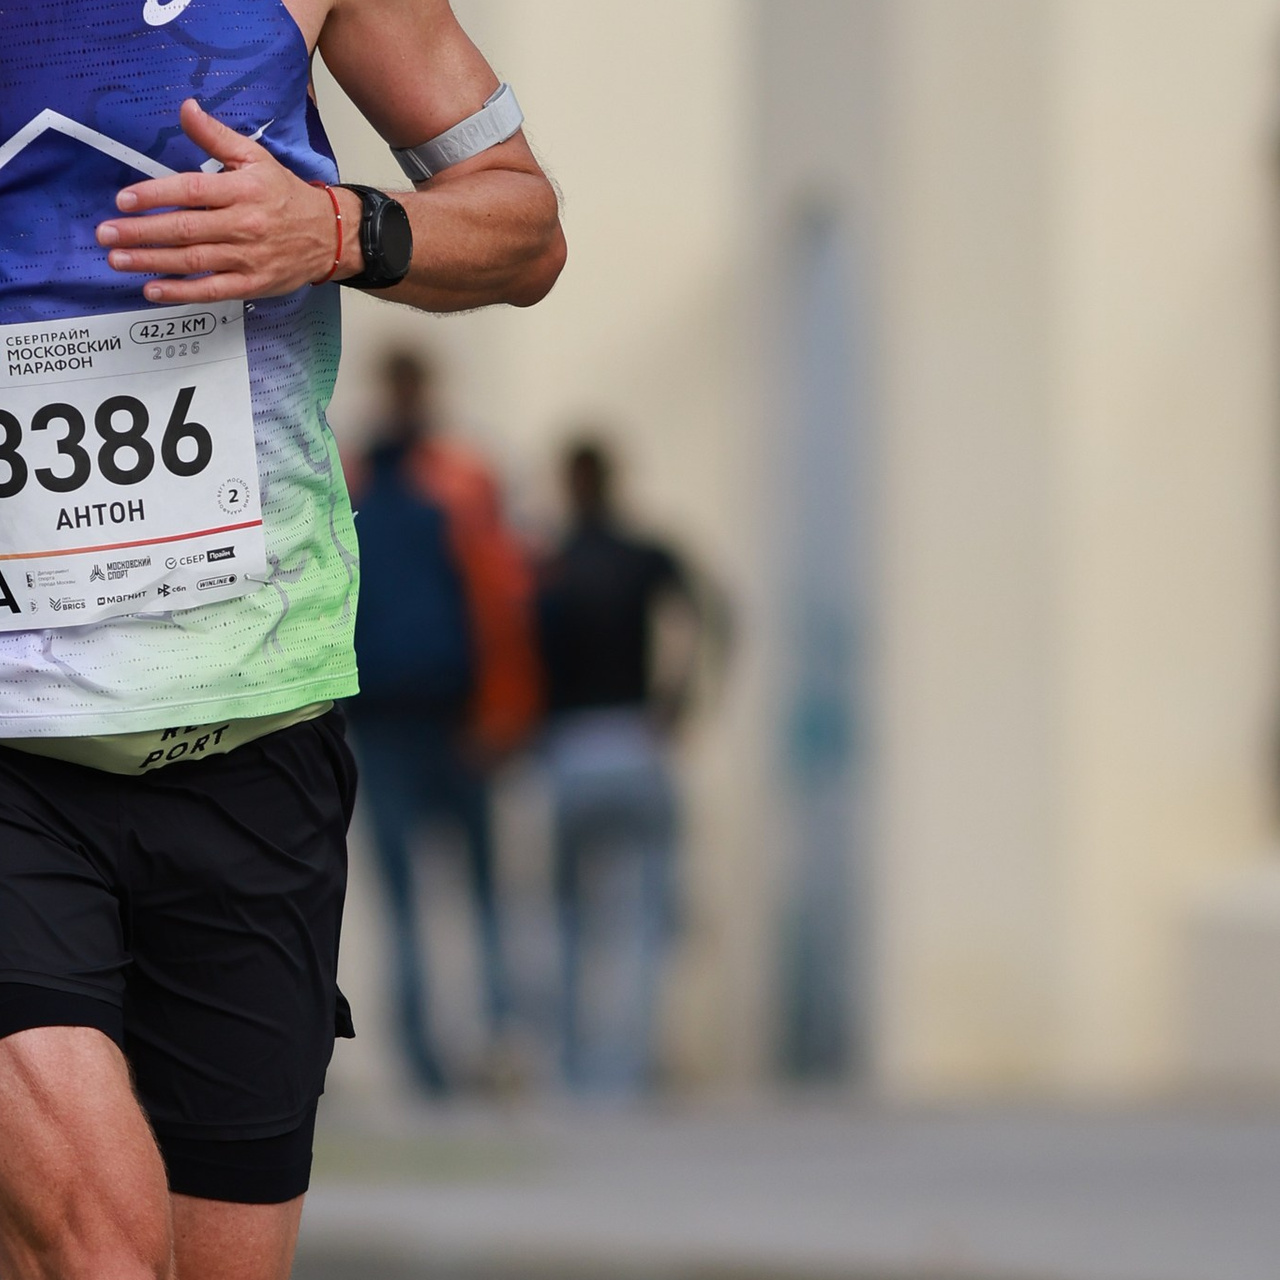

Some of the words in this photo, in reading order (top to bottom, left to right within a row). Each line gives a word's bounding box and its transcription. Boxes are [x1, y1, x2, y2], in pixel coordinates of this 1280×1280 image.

[6, 328, 90, 347] СБЕРПРАЙМ
[140, 322, 175, 339] 42,2
[8, 335, 122, 361] МОСКОВСКИЙ
[153, 341, 200, 360] 2026
[9, 356, 93, 376] МАРАФОН
[228, 488, 239, 503] 2
[55, 498, 145, 530] АНТОН
[106, 556, 152, 570] МОСКОВСКИЙ
[179, 553, 205, 566] СБЕР
[209, 549, 231, 560] Прайм
[107, 570, 129, 581] СПОРТ
[199, 577, 229, 588] WINLINE
[62, 601, 86, 611] BRICS
[138, 724, 230, 768] PORT
